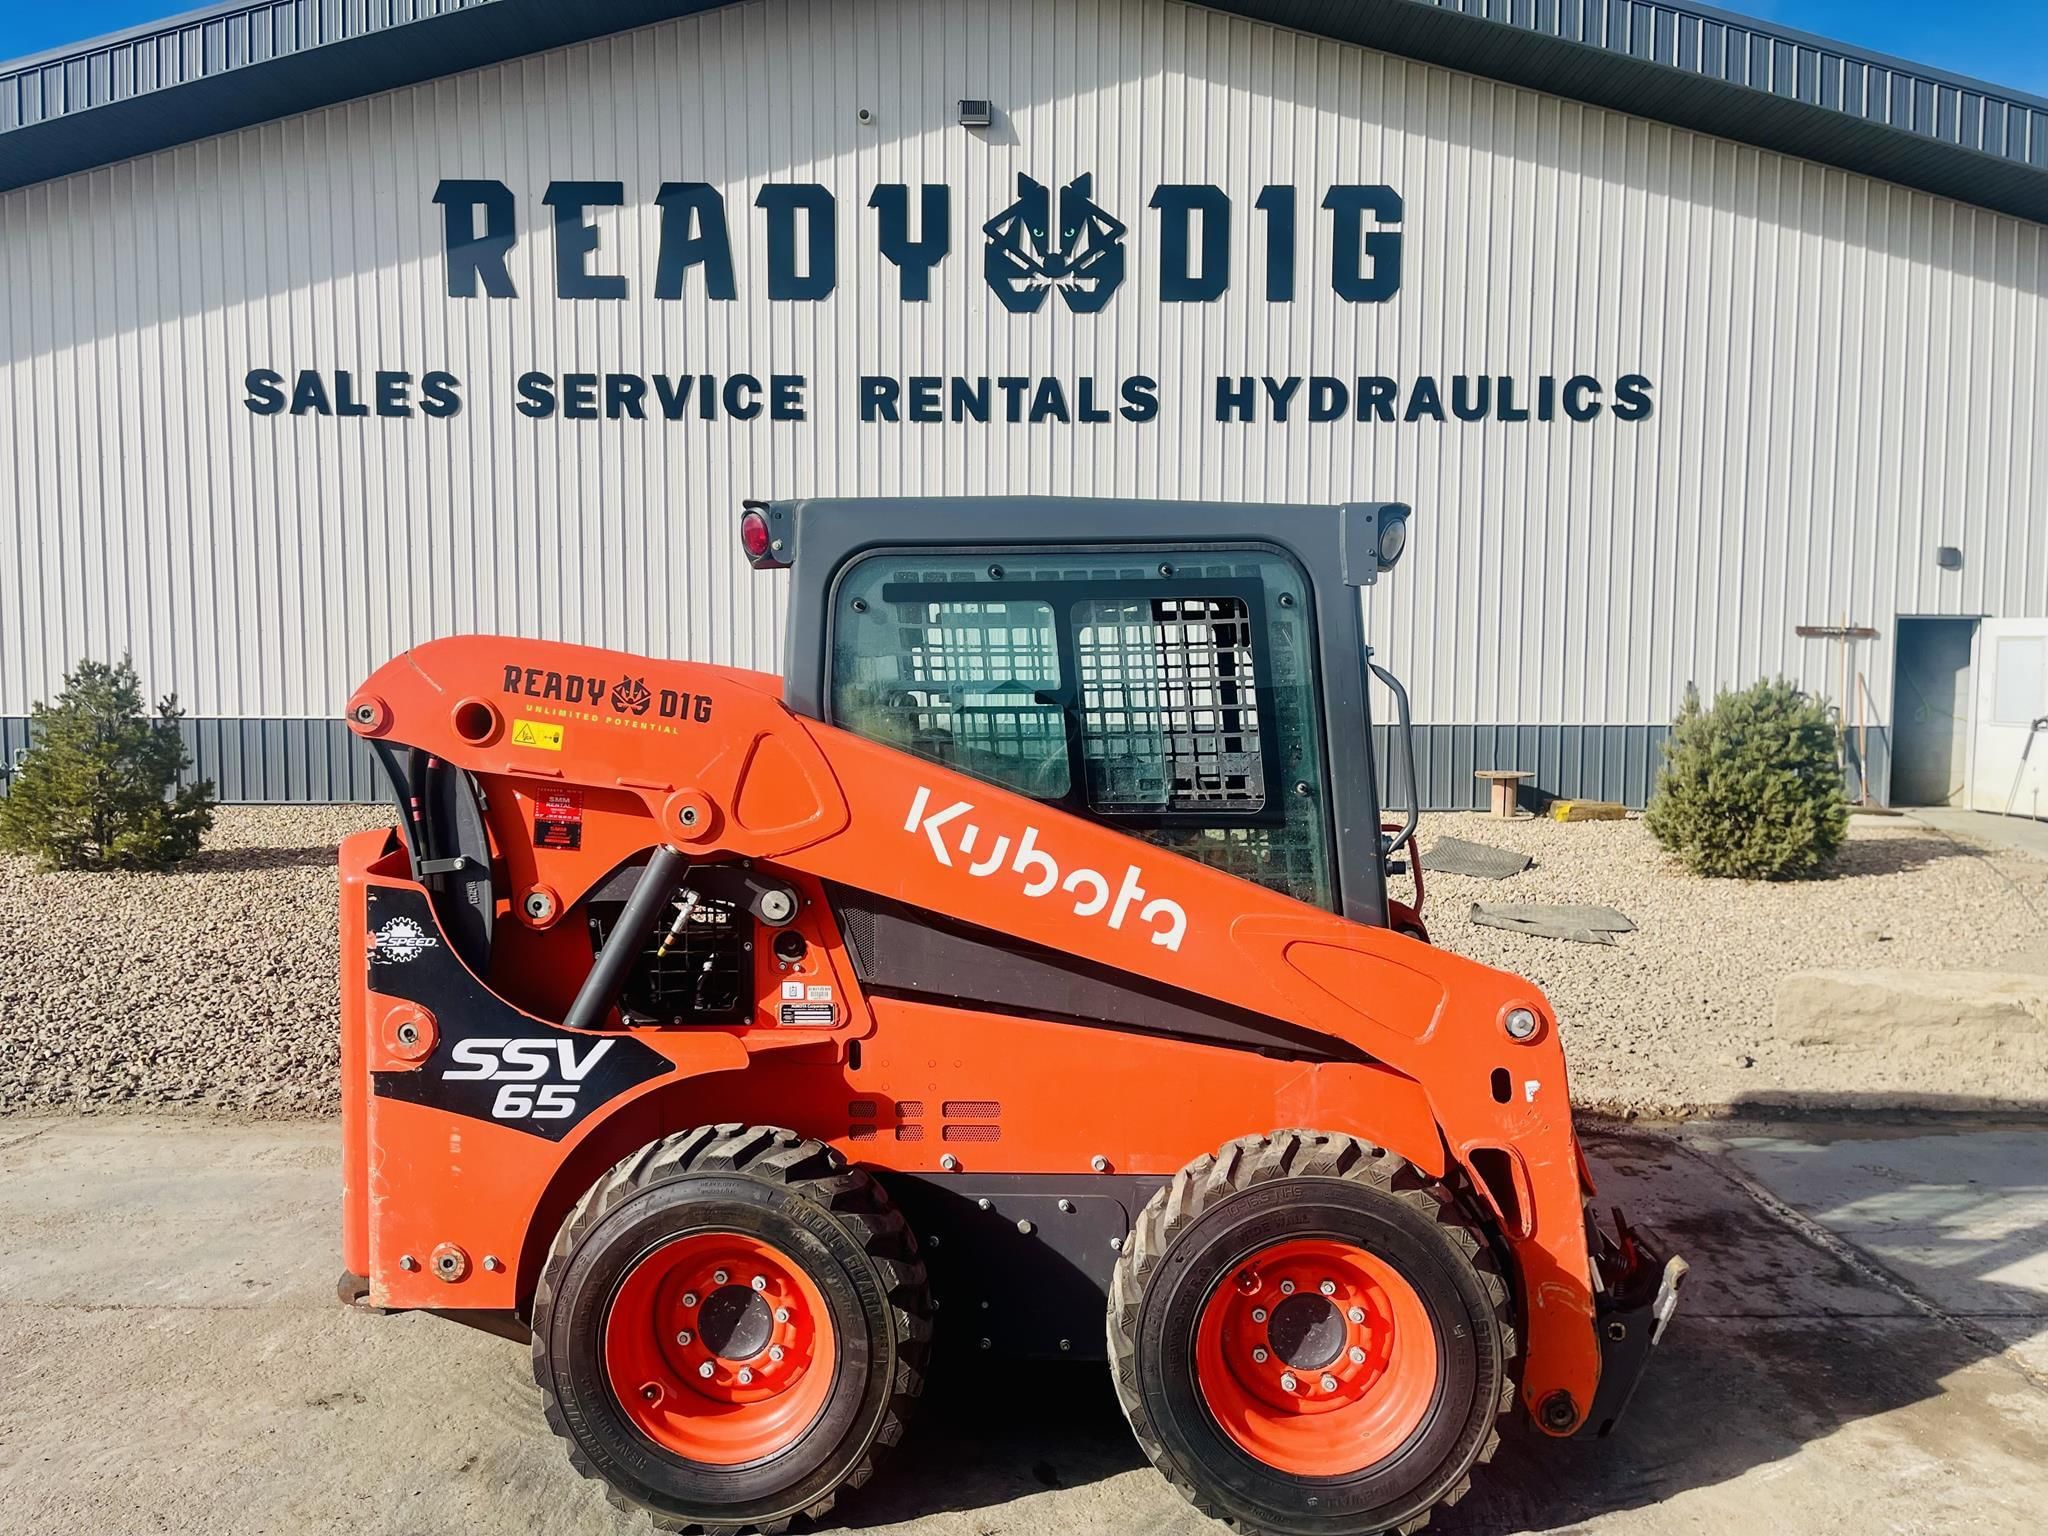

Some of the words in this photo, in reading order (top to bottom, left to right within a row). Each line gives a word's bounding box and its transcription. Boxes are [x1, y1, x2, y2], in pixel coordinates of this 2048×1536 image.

[432, 180, 949, 303] READY
[244, 368, 459, 418] SALES
[517, 373, 804, 421] SERVICE
[861, 375, 1159, 423] RENTALS
[1216, 374, 1651, 423] HYDRAULICS
[503, 665, 606, 706] READY
[526, 704, 599, 722] UNLIMITED
[605, 716, 679, 735] POTENTIAL
[903, 785, 1187, 952] Kubota
[442, 1038, 616, 1081] SSV
[491, 1084, 581, 1119] 65
